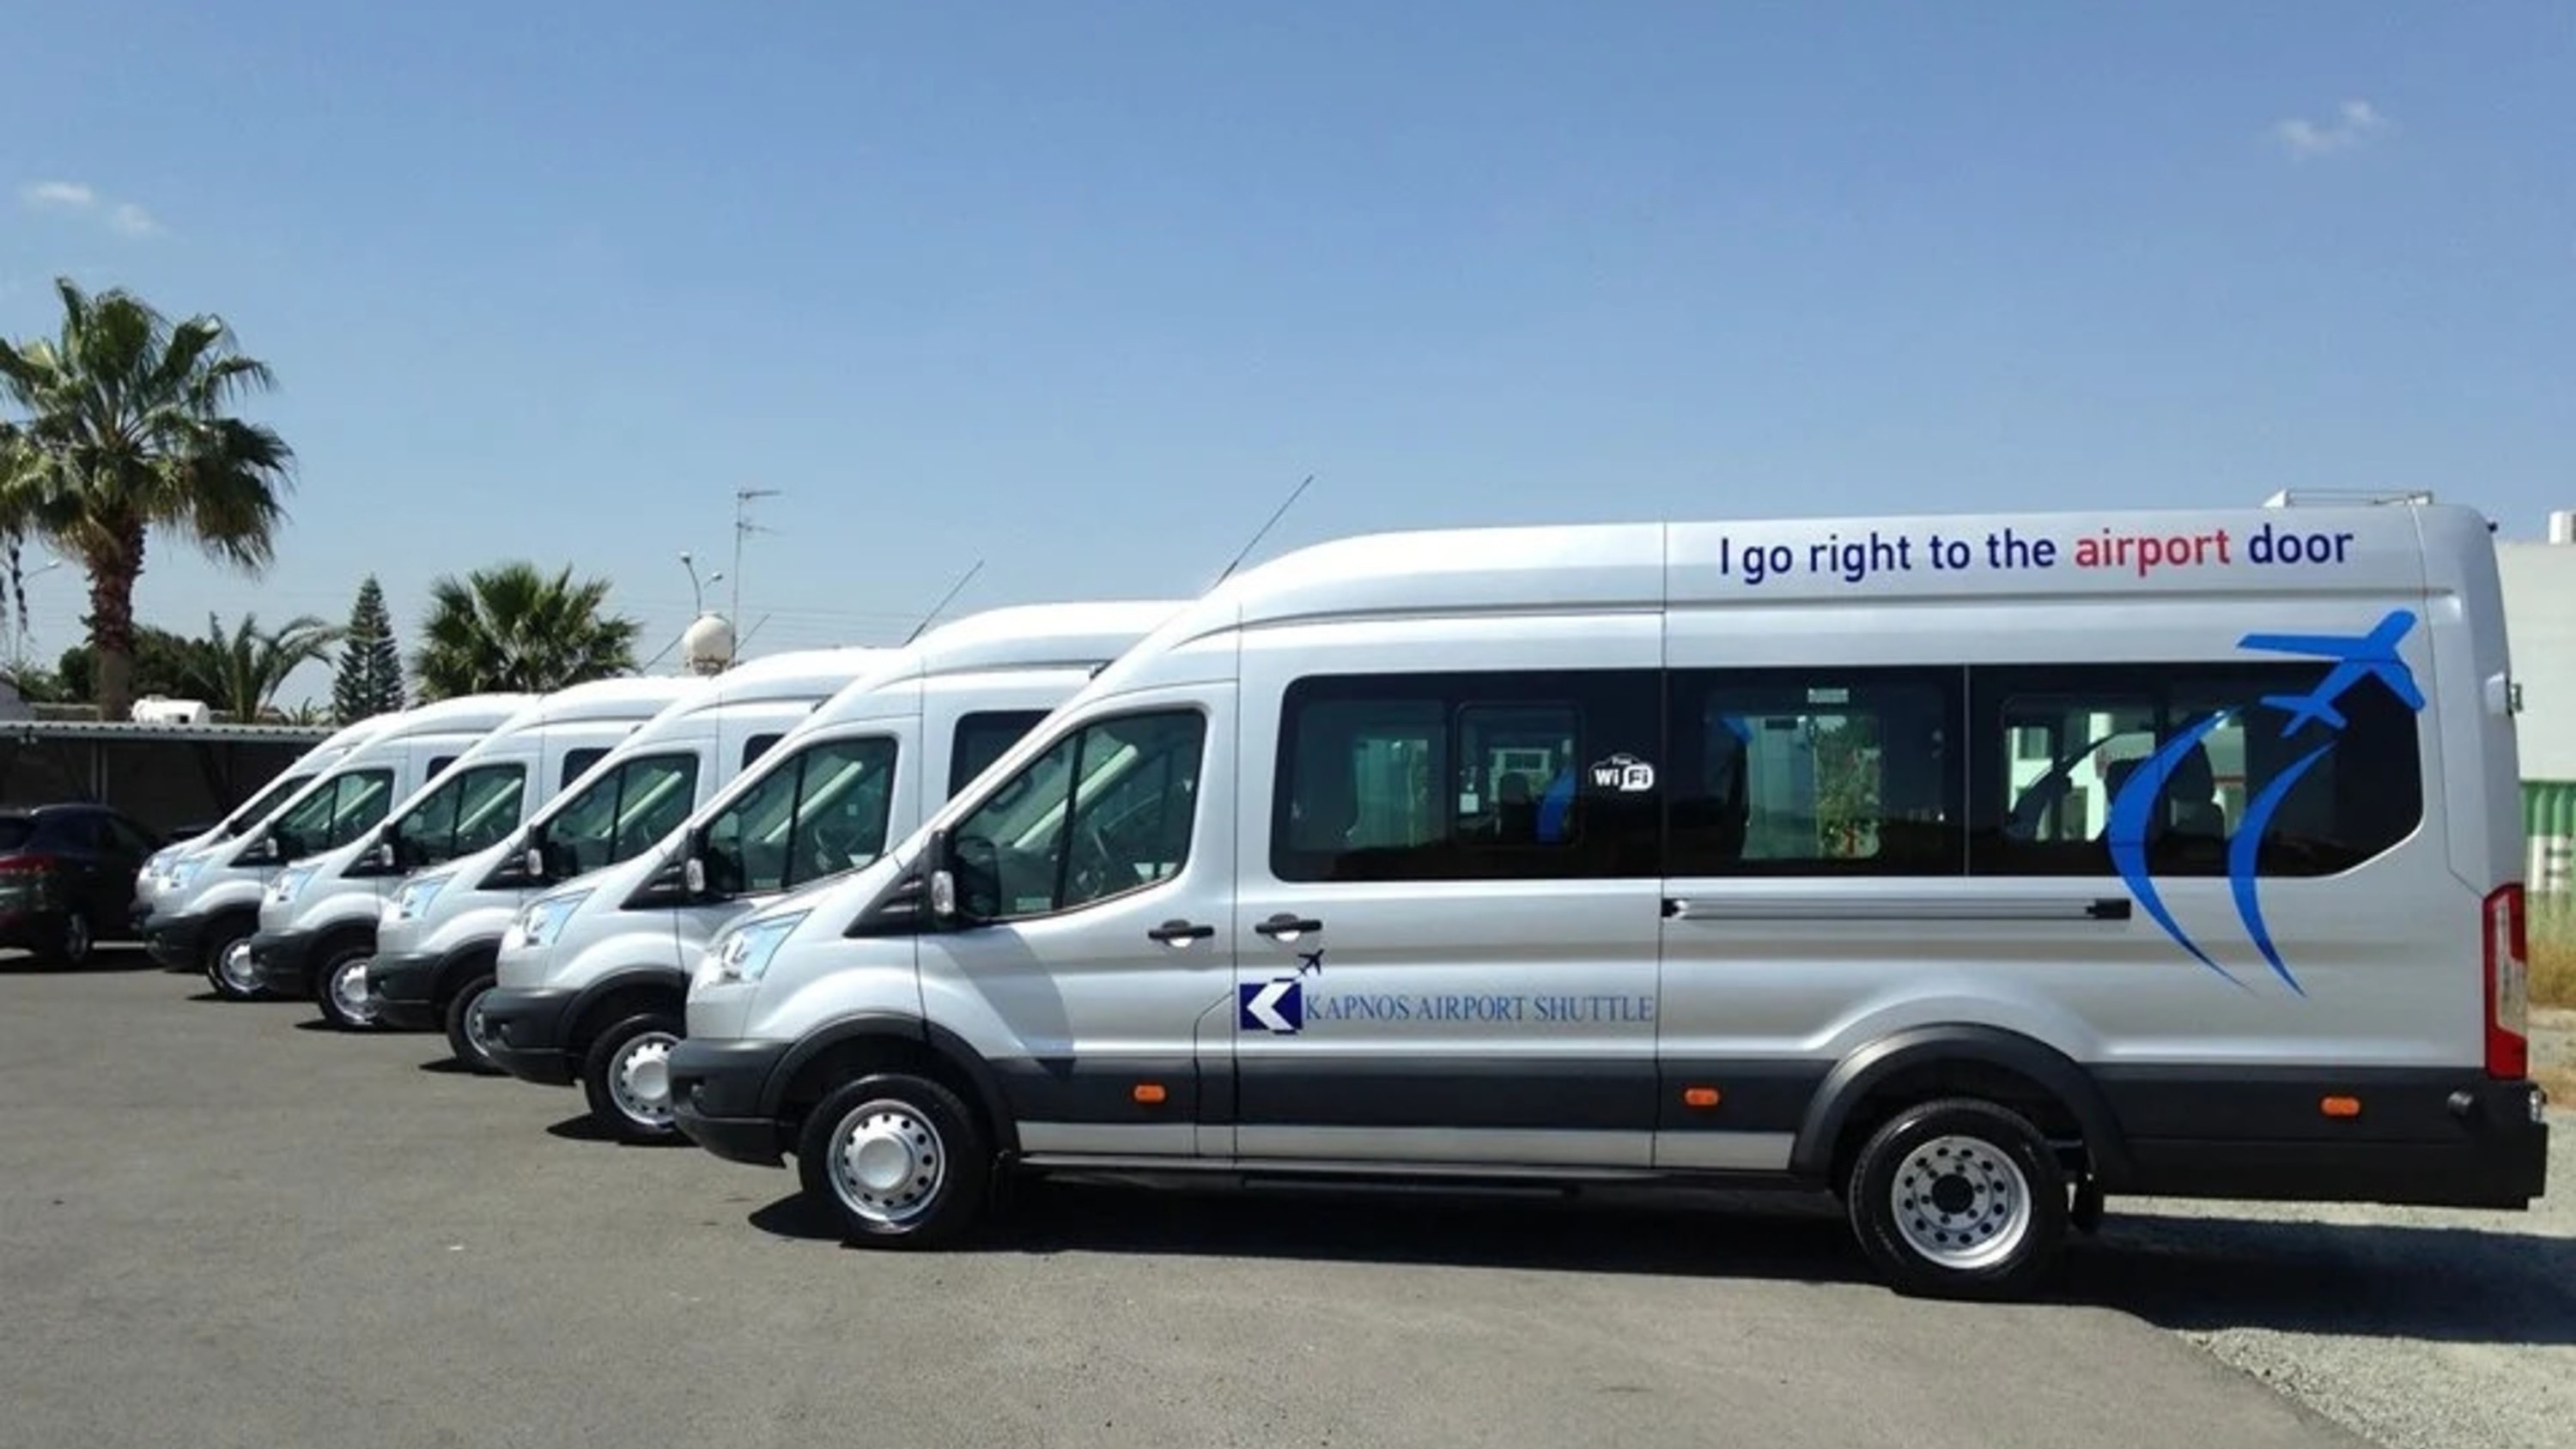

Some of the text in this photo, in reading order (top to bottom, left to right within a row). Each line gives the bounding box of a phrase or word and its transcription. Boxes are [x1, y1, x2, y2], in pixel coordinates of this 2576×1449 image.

[1721, 524, 2354, 585] I go right to the airport door
[1305, 994, 1654, 1023] KAPNOS AIRPORT SHUTTLE
